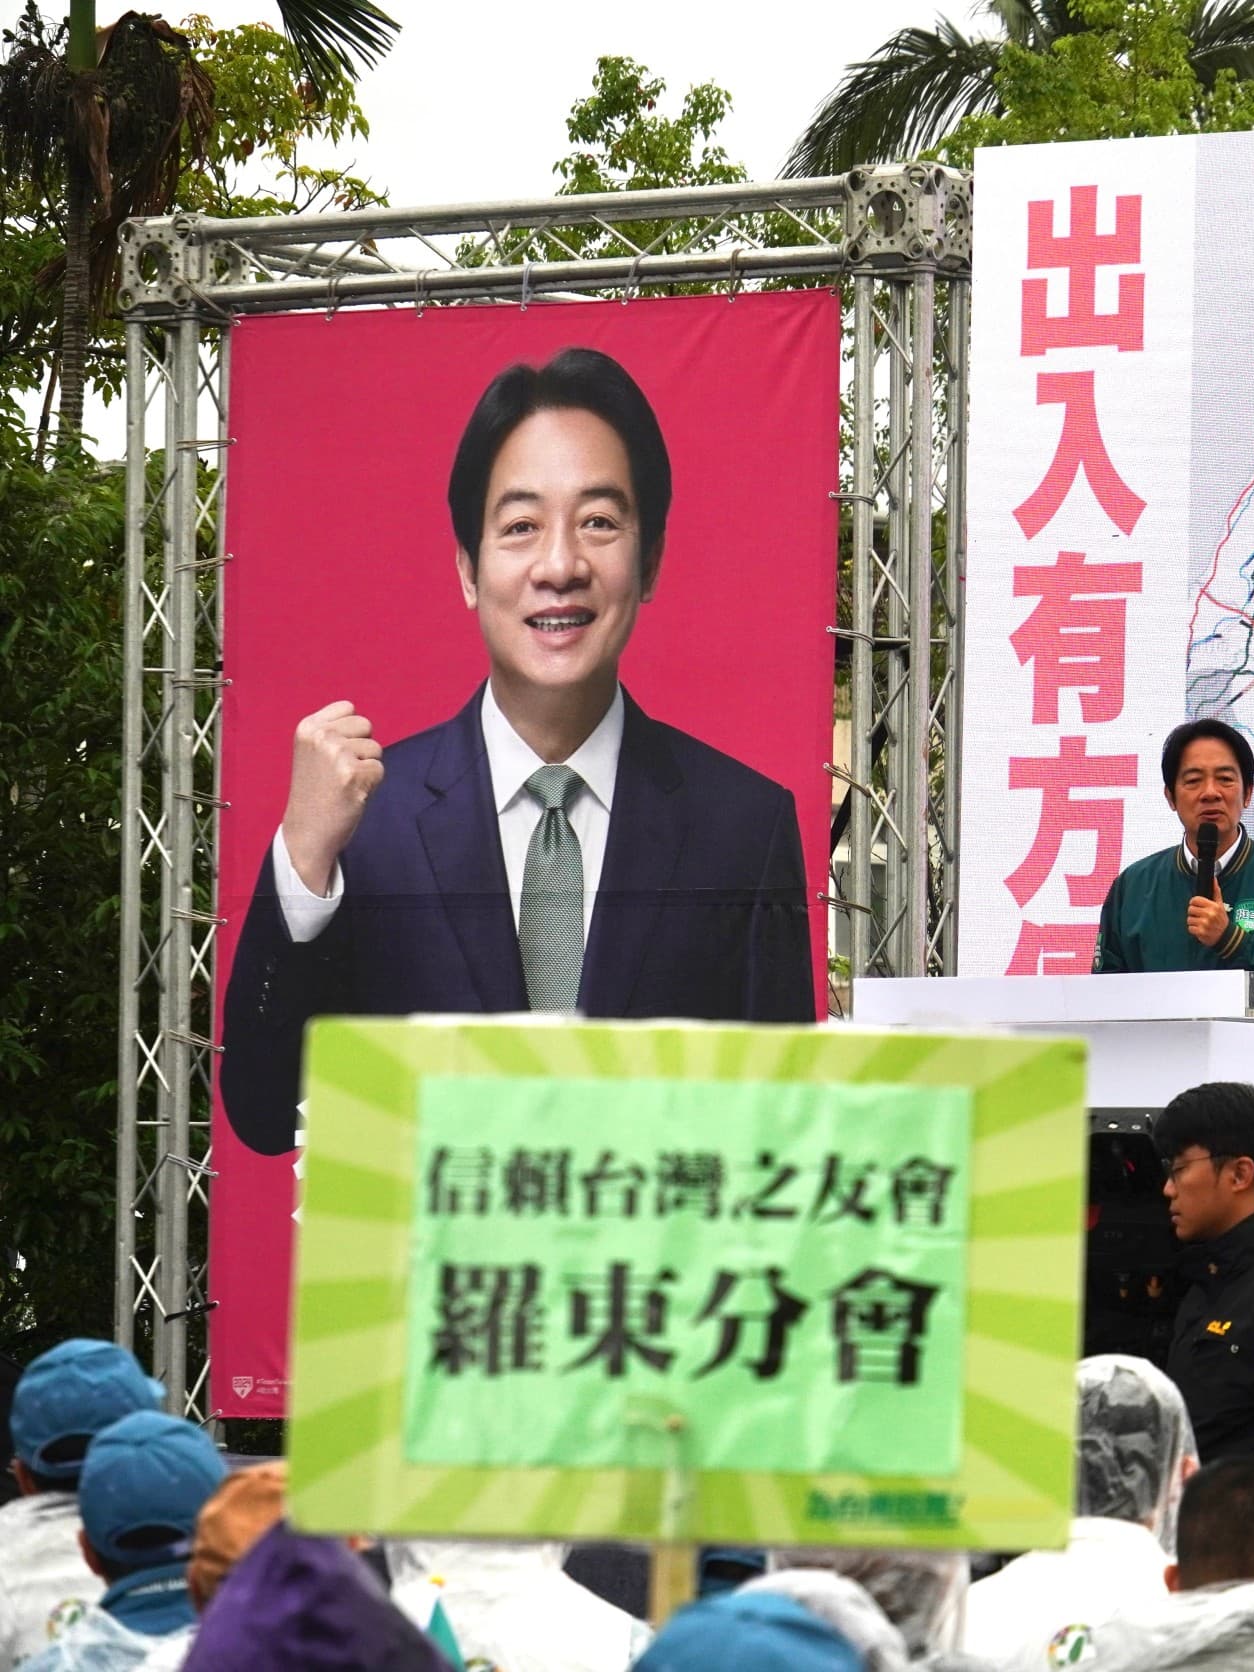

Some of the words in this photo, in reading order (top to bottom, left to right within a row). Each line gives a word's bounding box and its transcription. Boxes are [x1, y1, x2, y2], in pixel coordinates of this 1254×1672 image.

[426, 1144, 958, 1227] 信賴台灣之友會
[428, 1261, 943, 1388] 羅東分會
